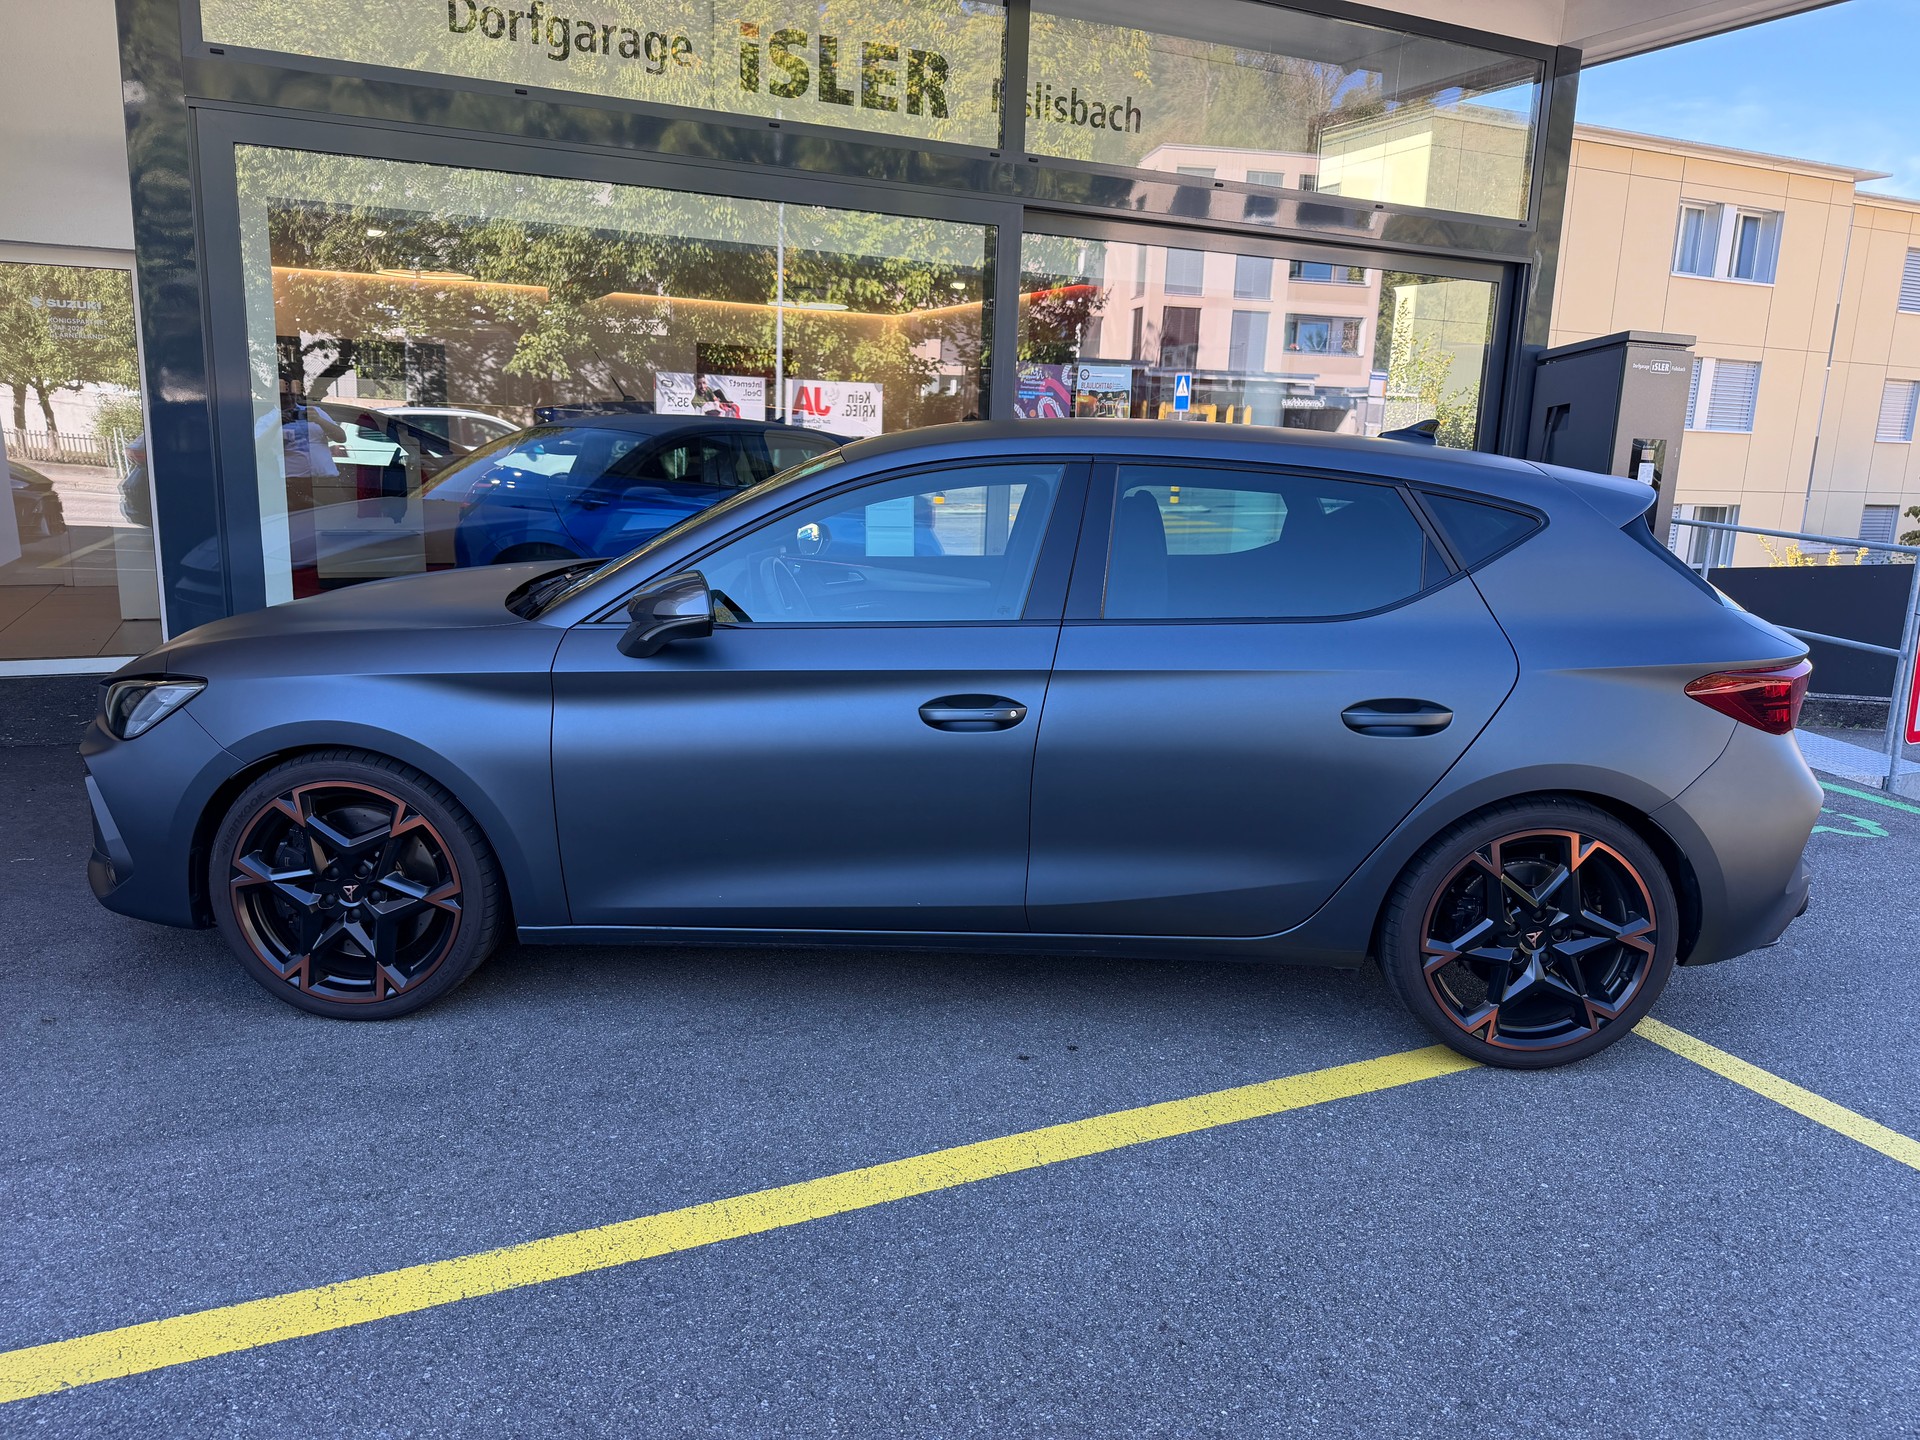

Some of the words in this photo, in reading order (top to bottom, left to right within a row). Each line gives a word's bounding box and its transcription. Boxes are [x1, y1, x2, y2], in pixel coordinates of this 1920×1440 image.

[448, 0, 693, 75] Dorfgarage
[739, 22, 950, 119] iSLER
[46, 298, 103, 311] SUZUKI
